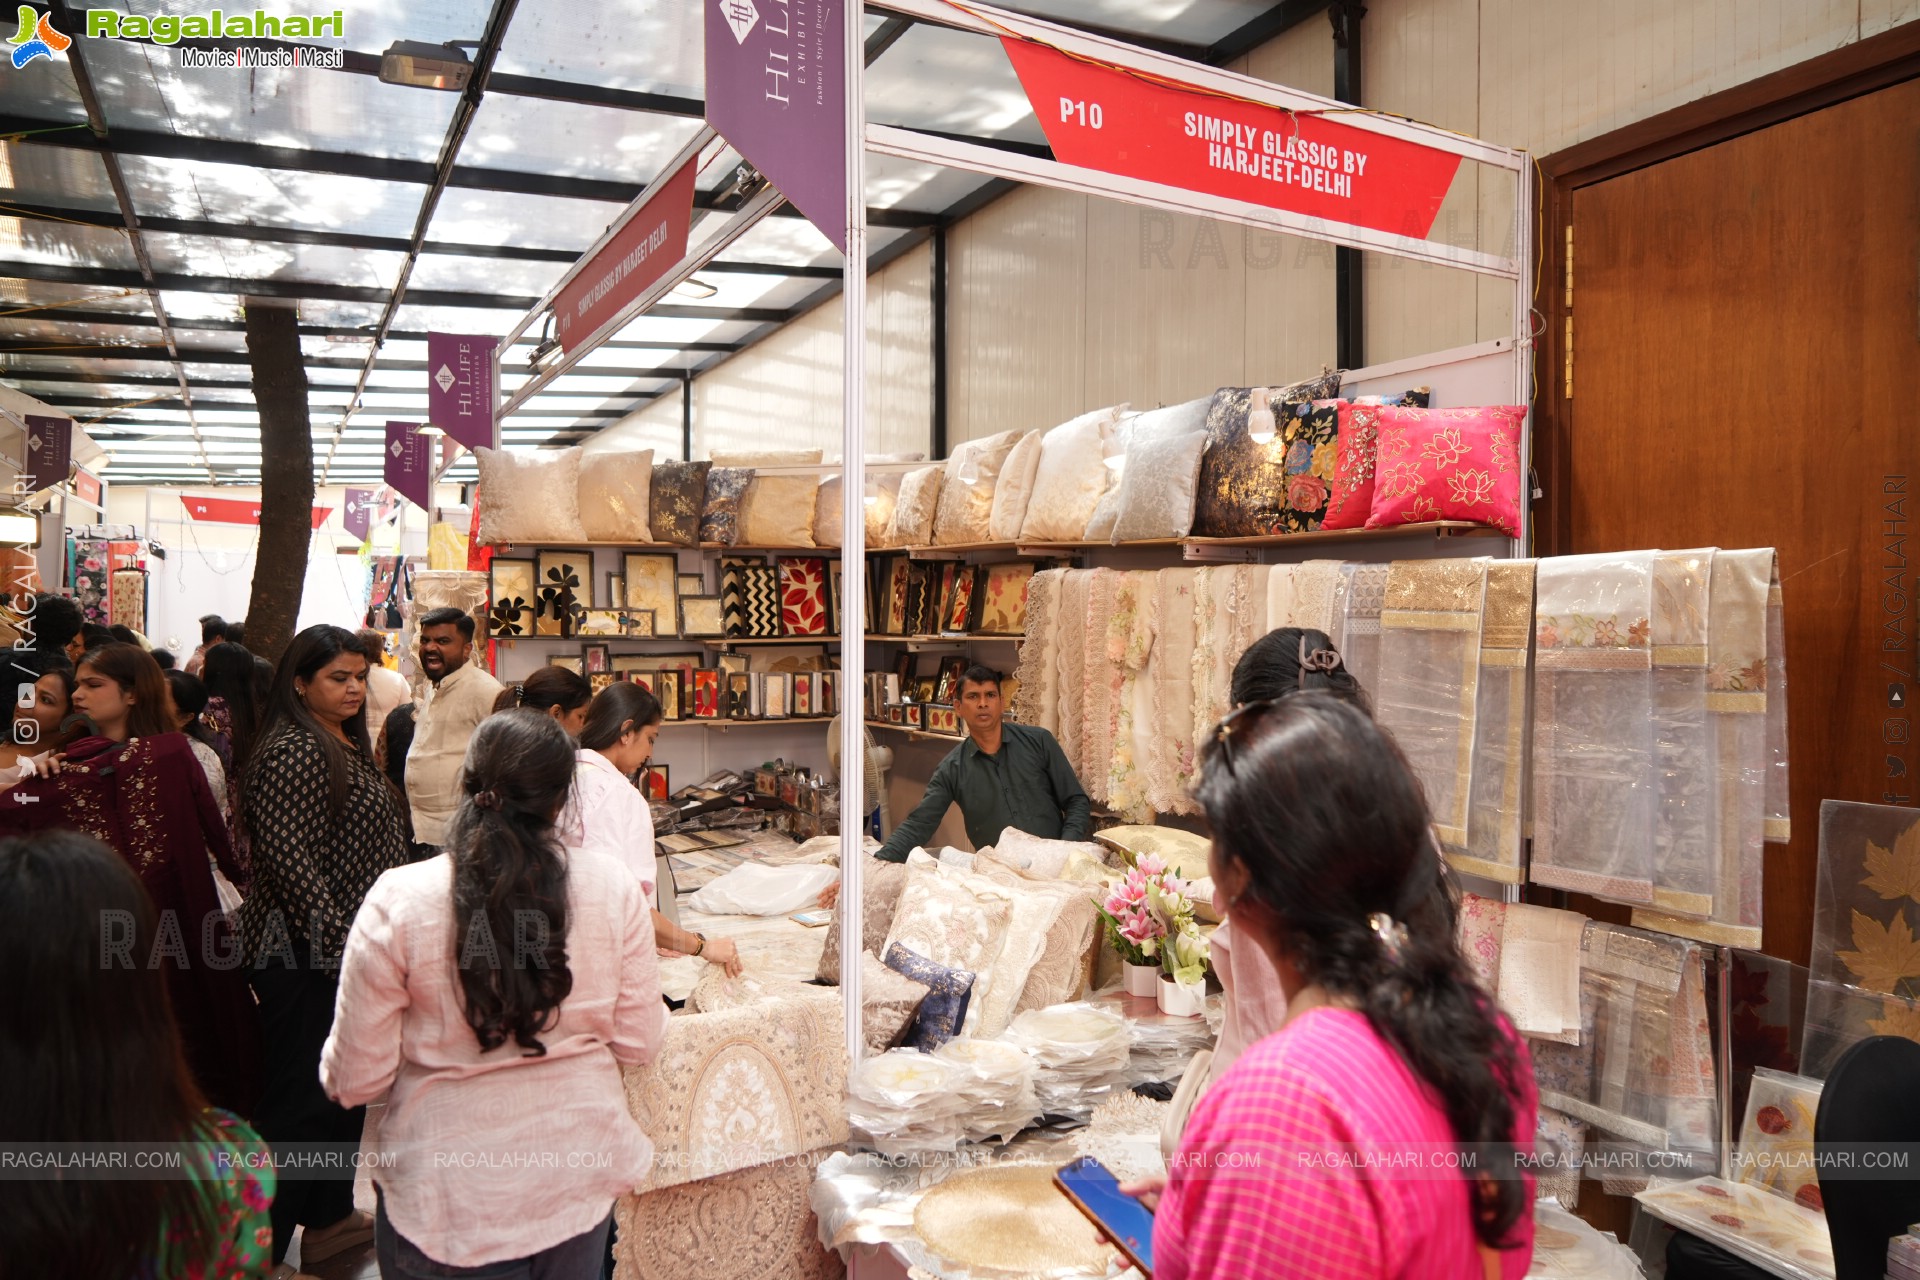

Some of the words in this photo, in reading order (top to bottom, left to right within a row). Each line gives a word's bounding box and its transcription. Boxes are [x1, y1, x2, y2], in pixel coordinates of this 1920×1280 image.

[765, 49, 790, 107] HI
[1060, 97, 1103, 130] P10
[1184, 111, 1258, 150] SIMPLY
[1343, 150, 1368, 177] BY
[1208, 142, 1352, 199] HARJEET-DELHI
[578, 288, 595, 318] SIMPLY
[614, 263, 622, 284] BY
[623, 238, 648, 276] HARJEET
[649, 220, 668, 255] DELHI
[458, 343, 471, 387] LIFE
[458, 393, 472, 417] HI
[44, 421, 55, 449] LIFE
[404, 426, 415, 453] LIFE
[43, 451, 54, 466] HI
[403, 456, 413, 473] HI
